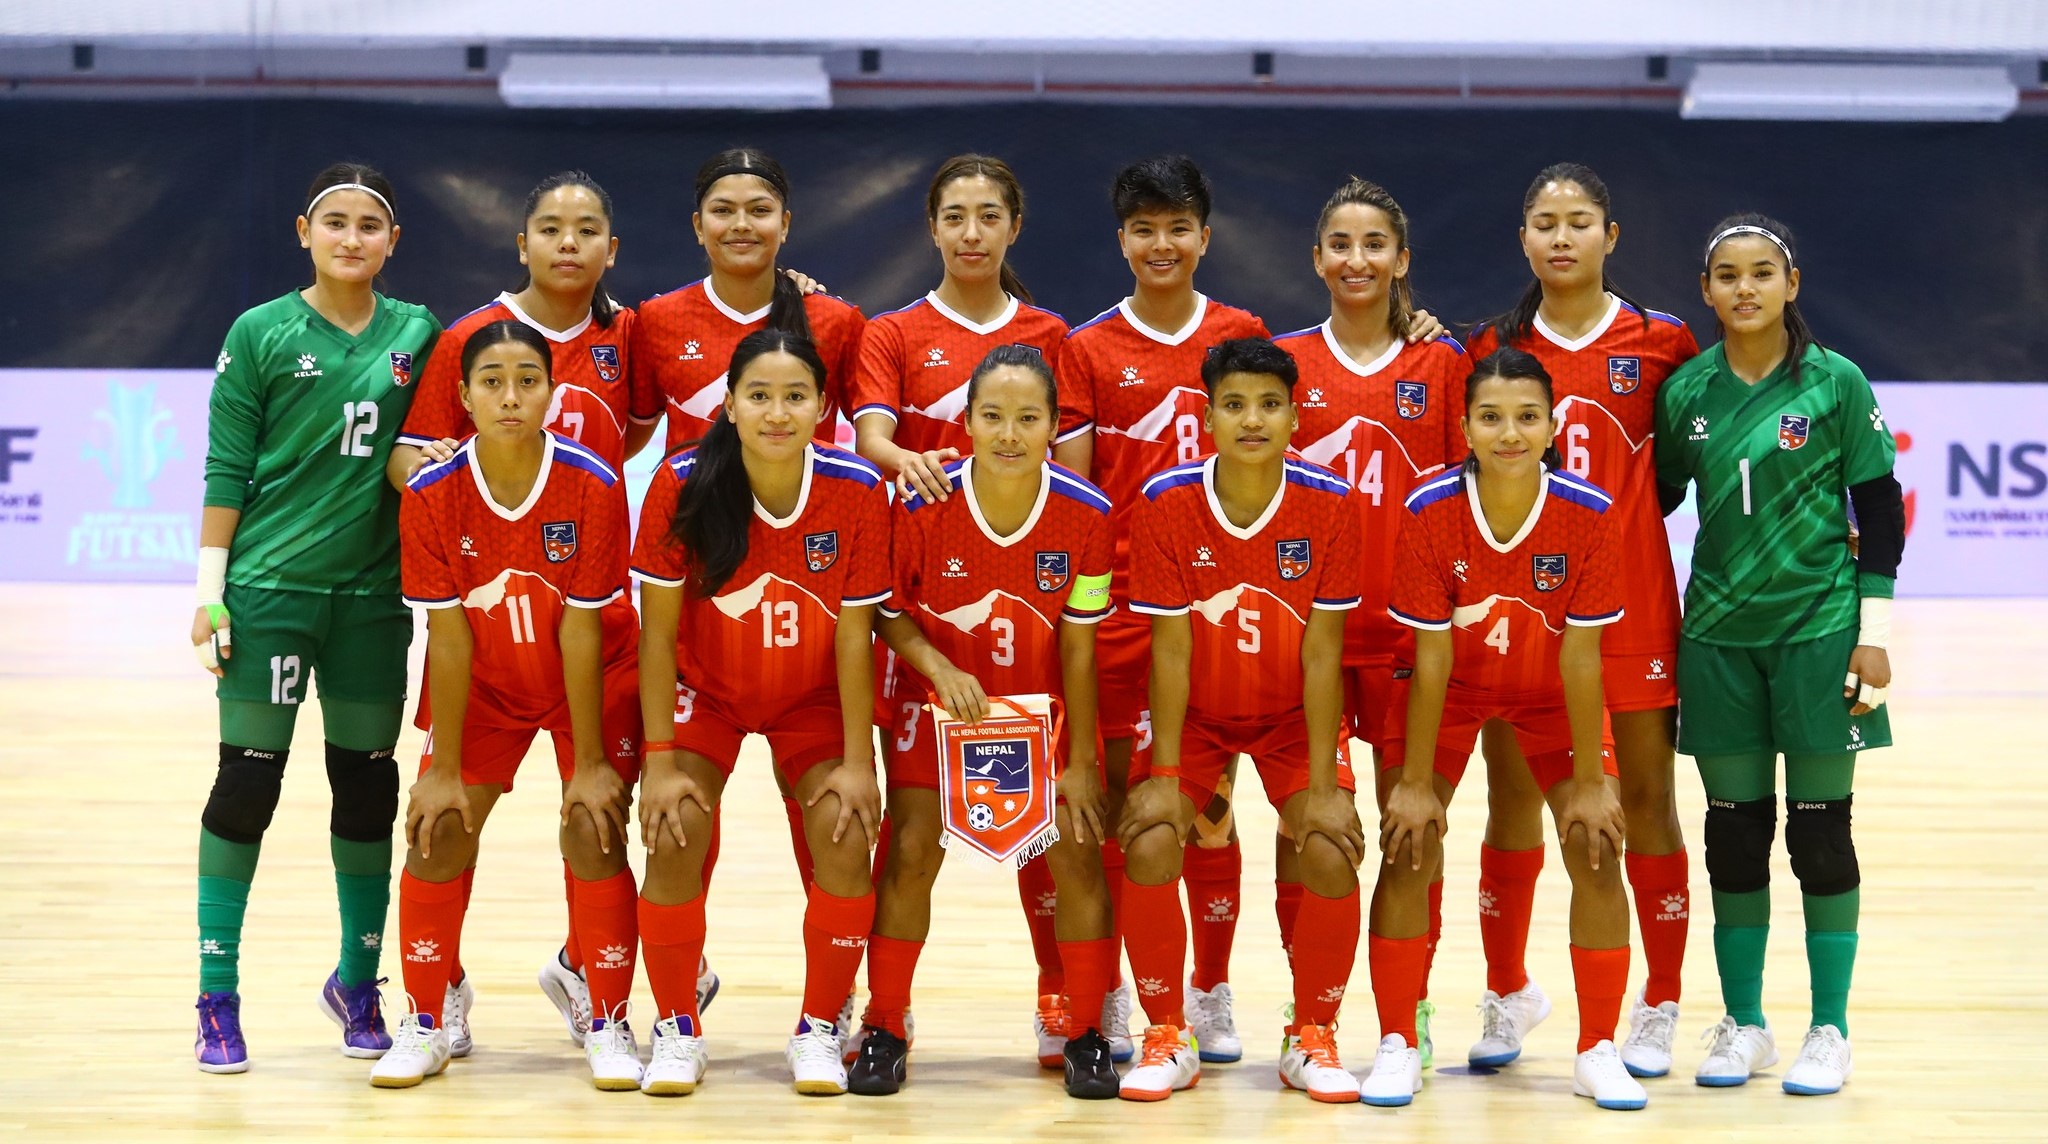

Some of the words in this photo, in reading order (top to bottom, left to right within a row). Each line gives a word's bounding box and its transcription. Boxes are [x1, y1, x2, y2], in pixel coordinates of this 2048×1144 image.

[679, 353, 704, 361] KELME
[924, 360, 949, 368] KELME
[294, 369, 323, 378] KELME
[1119, 378, 1145, 388] KELME
[340, 401, 379, 457] 12
[562, 412, 585, 443] 7
[1175, 414, 1200, 465] 8
[1688, 433, 1710, 441] KELME
[1566, 423, 1590, 480] 6
[1946, 443, 2048, 499] NS
[1345, 449, 1384, 506] 14
[1739, 458, 1752, 515] 1
[1285, 542, 1301, 550] NEPAL
[461, 550, 479, 558] ELME
[1191, 560, 1217, 568] KELME
[505, 593, 536, 644] 11
[760, 600, 799, 648] 13
[1236, 606, 1261, 654] 5
[1483, 616, 1510, 656] 4
[990, 616, 1015, 668] 3
[270, 655, 301, 705] 12
[896, 701, 921, 752] 3
[950, 729, 960, 737] ALL
[961, 728, 978, 736] NEPAL
[978, 727, 1004, 735] FOOTBALL
[1005, 725, 1040, 734] ASSOCIATION
[975, 745, 1016, 756] NEPAL
[1804, 802, 1827, 810] asics
[1035, 908, 1056, 916] KEL
[1656, 911, 1688, 921] KELME
[1204, 914, 1235, 923] KELME
[831, 937, 867, 948] KELM
[406, 953, 442, 963] KELME
